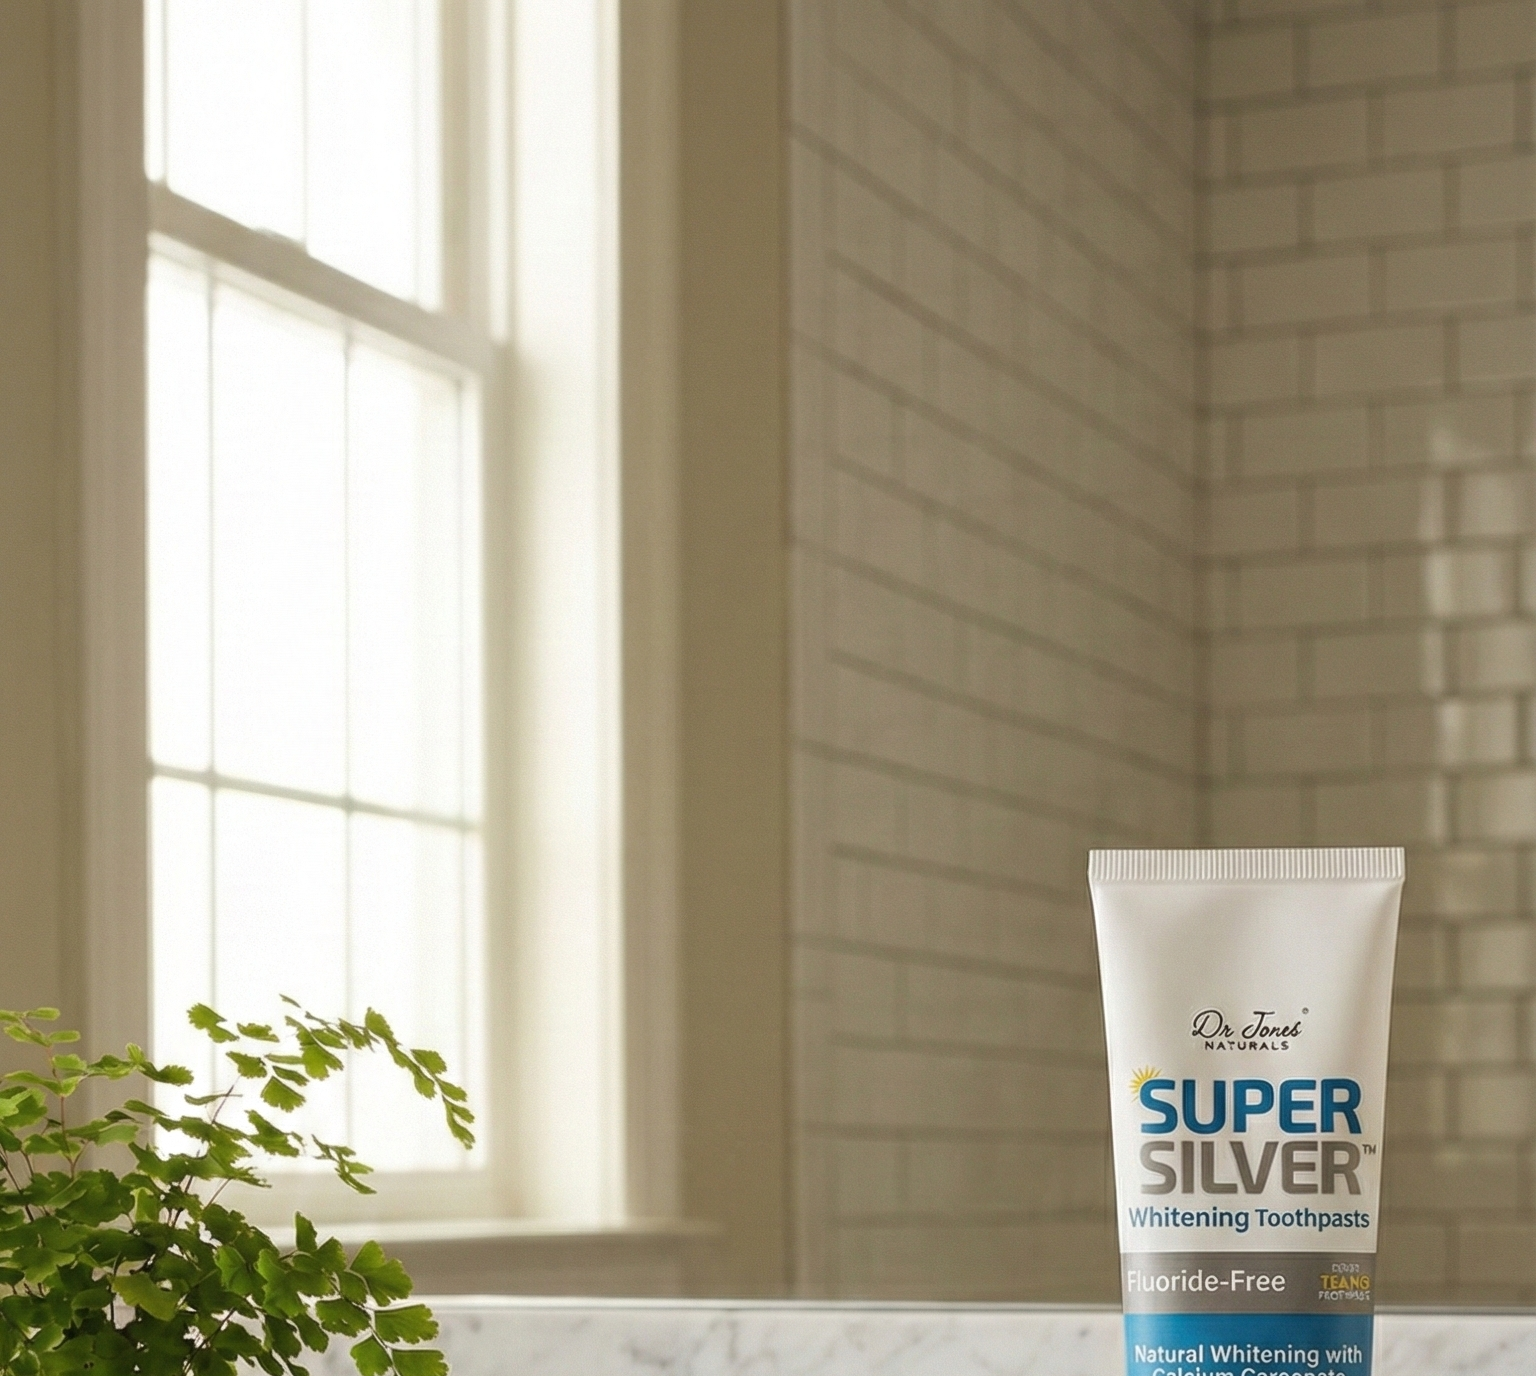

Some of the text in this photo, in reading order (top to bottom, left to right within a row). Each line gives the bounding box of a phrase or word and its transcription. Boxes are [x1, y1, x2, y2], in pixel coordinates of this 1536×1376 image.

[1192, 1010, 1302, 1038] Dr Jones
[1205, 1041, 1289, 1050] NATURALS
[1139, 1079, 1361, 1134] SUPER
[1140, 1141, 1361, 1195] SILVER
[1129, 1206, 1370, 1233] Whitening Toothpasts
[1127, 1269, 1286, 1292] Fluoride-Free
[1135, 1345, 1362, 1368] Natural Whitening with
